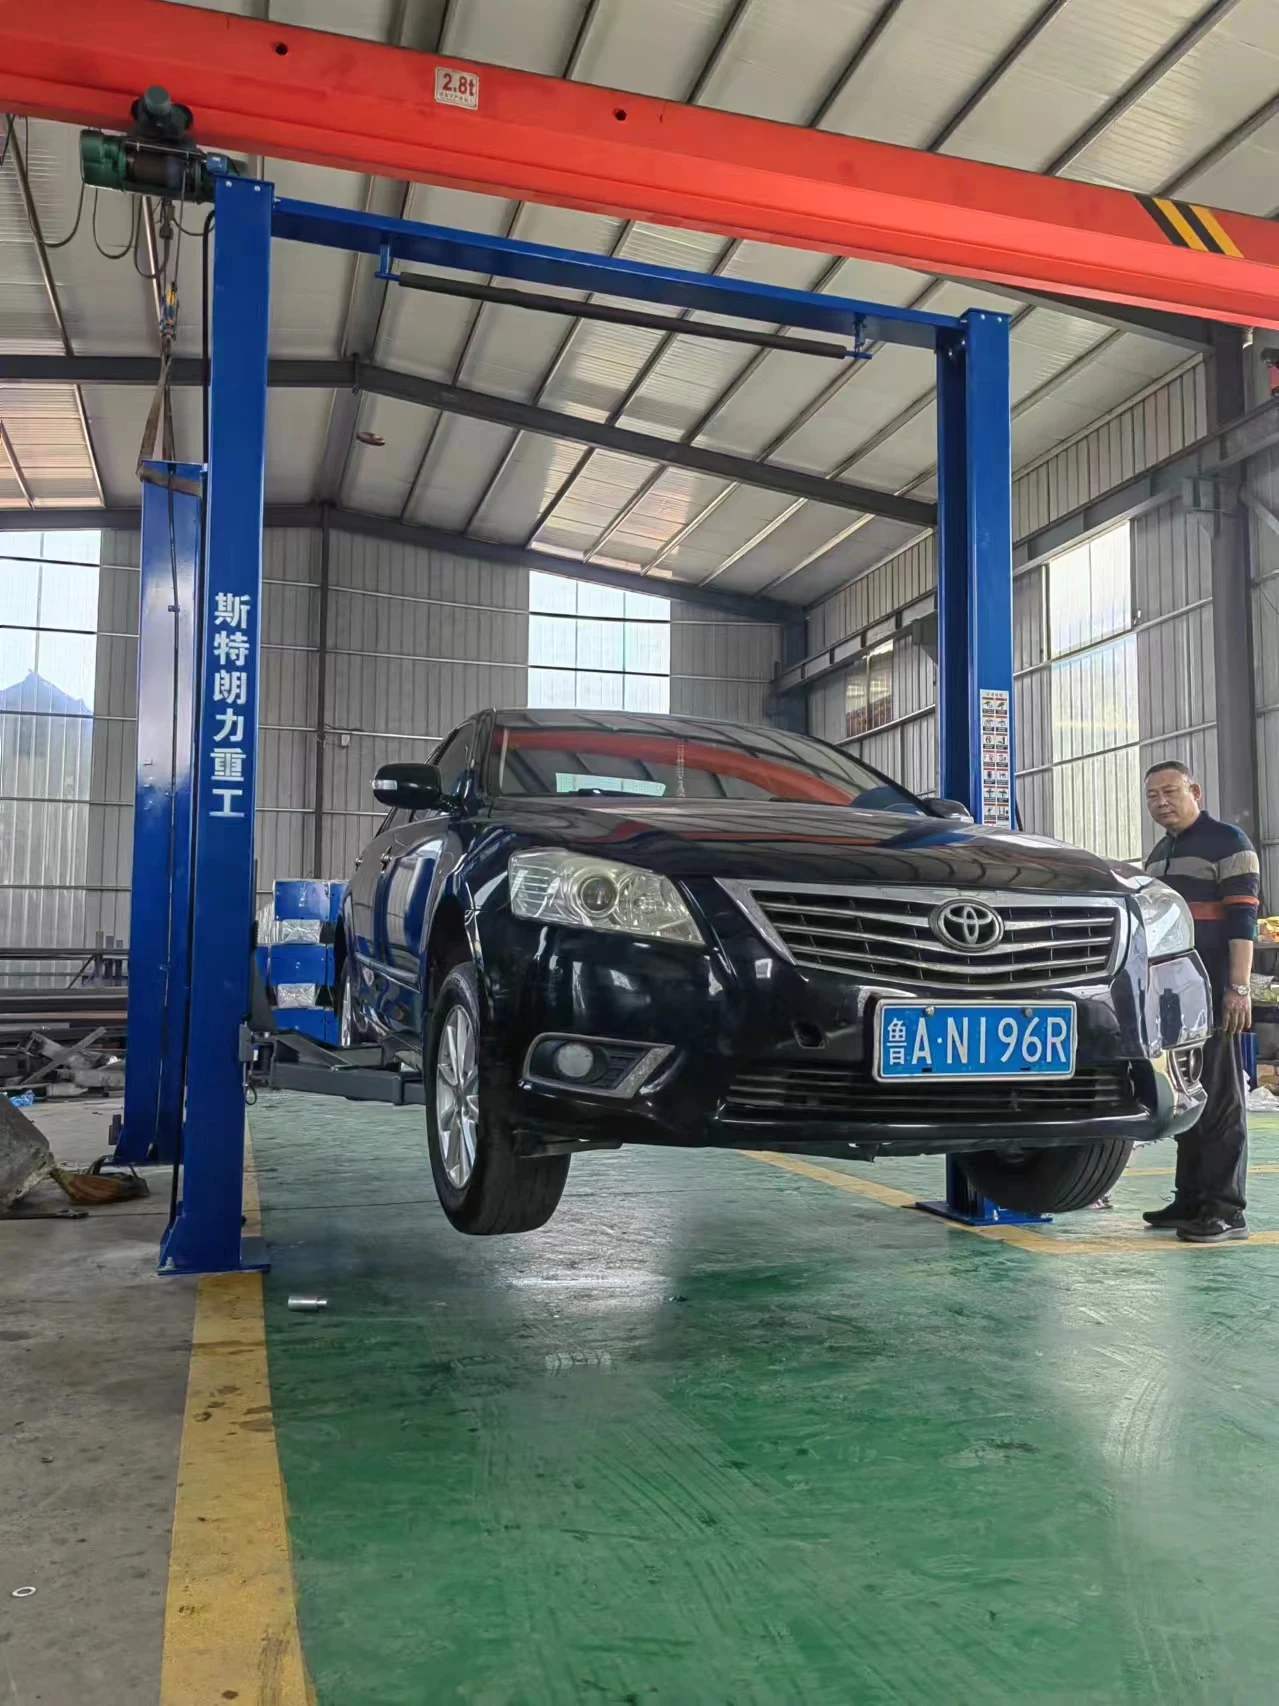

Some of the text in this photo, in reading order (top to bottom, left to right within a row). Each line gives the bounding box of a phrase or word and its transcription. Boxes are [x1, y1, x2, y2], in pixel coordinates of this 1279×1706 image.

[442, 72, 475, 97] 2.8t
[209, 592, 251, 818] 斯特朗力重工
